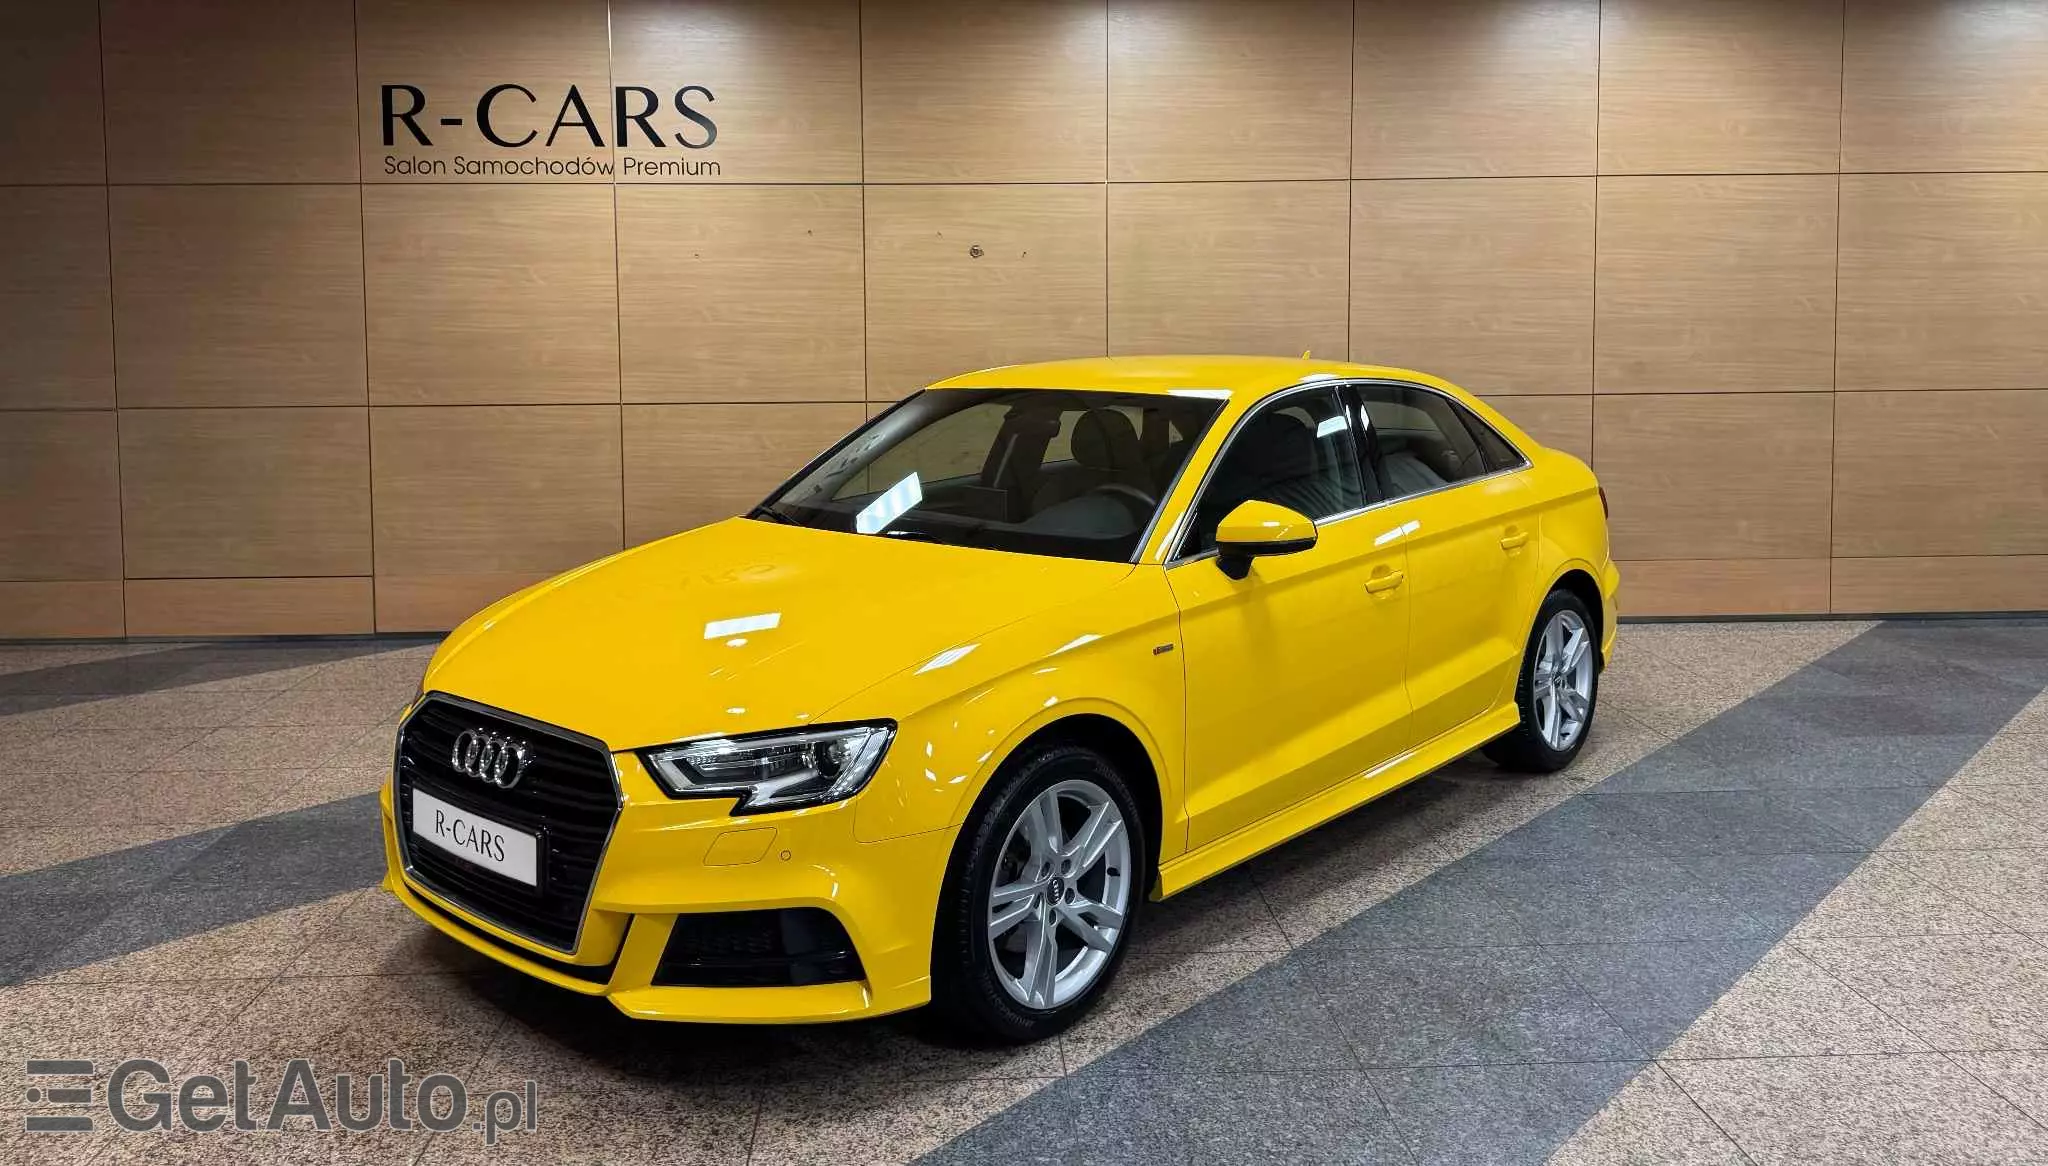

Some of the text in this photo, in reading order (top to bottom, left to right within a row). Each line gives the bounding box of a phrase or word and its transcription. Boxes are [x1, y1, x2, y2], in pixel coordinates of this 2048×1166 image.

[381, 84, 718, 148] R-CARS
[384, 155, 721, 176] Salon Samochodów Premium
[435, 809, 505, 862] R-CARS
